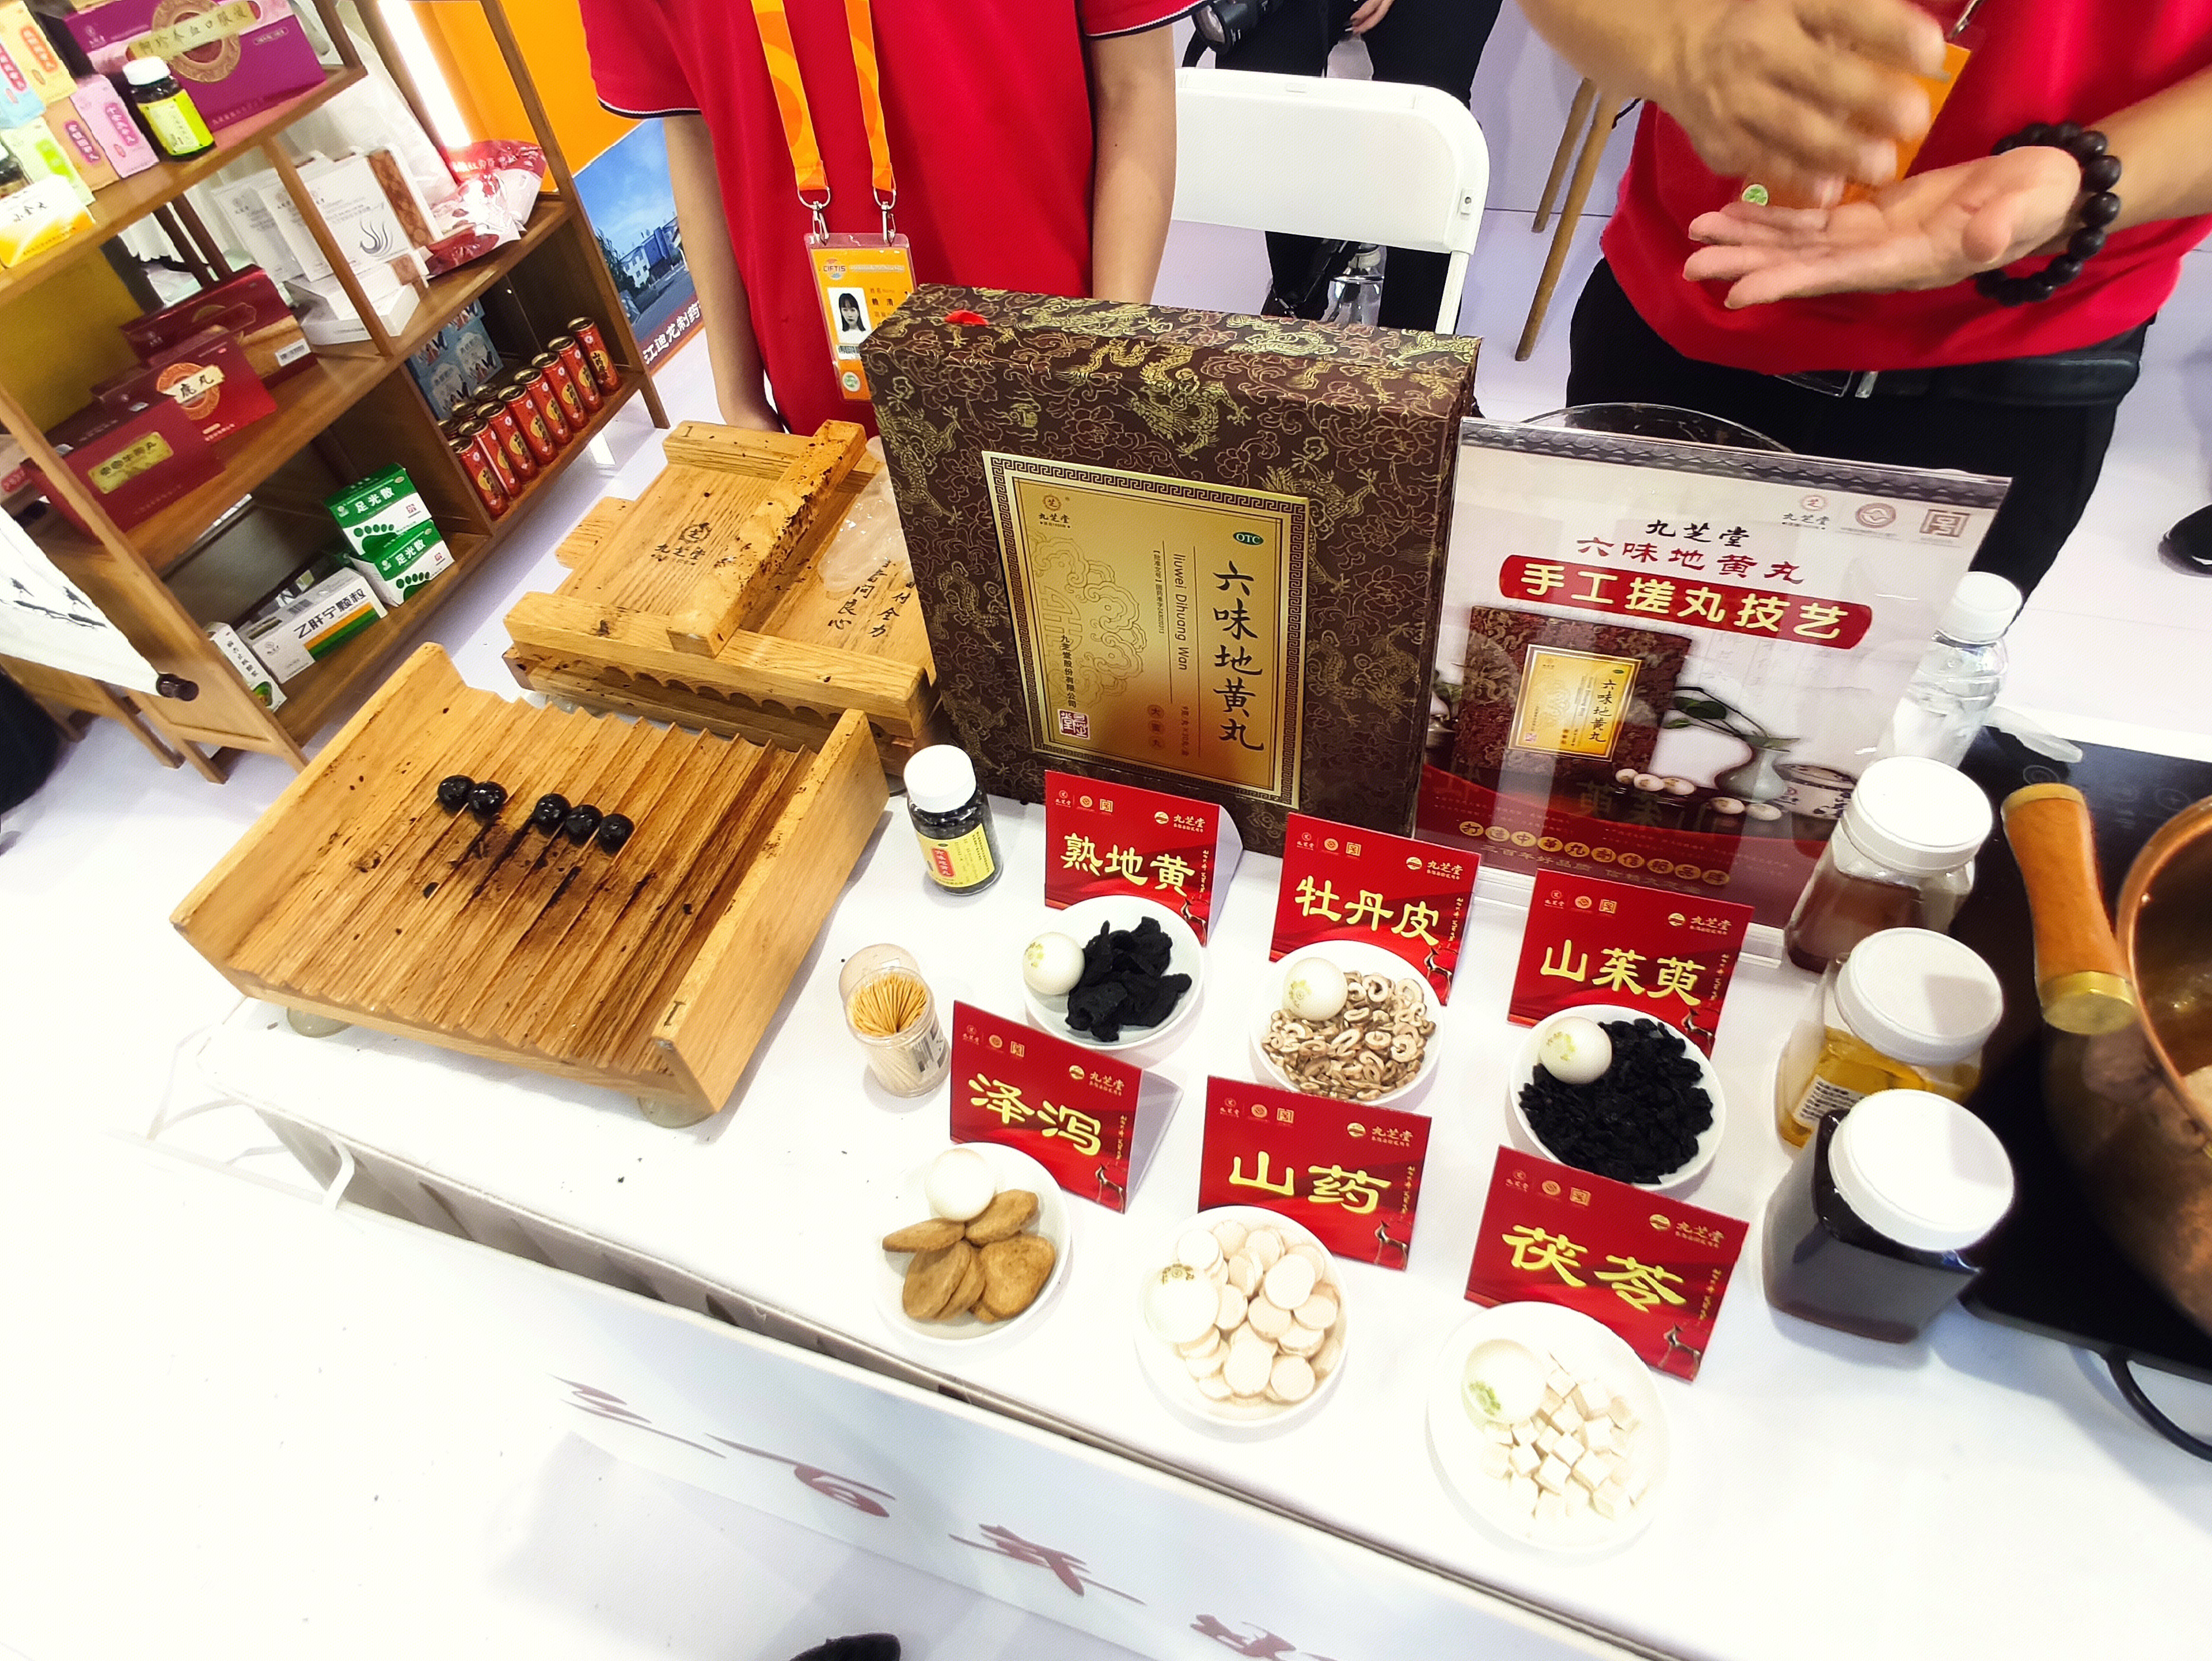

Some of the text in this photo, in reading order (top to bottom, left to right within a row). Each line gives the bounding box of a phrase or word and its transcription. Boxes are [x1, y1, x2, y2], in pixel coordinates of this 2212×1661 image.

[642, 300, 701, 364] 江迪龙制药
[354, 486, 395, 514] 足光散
[1039, 513, 1070, 524] 九芝堂
[1782, 512, 1831, 525] 九芝堂
[395, 539, 426, 566] 足光散
[654, 543, 706, 560] 九芝堂
[1236, 533, 1261, 544] OTC
[1645, 518, 1752, 549] 九芝堂
[1576, 536, 1807, 585] 六味地黄丸
[293, 588, 367, 639] 乙肝宁颗粒
[1174, 593, 1189, 641] Dihuang
[1520, 562, 1850, 640] 手工搓丸技艺
[1060, 634, 1077, 708] 九芝堂股份有限公司
[1177, 647, 1190, 670] Wan
[1212, 560, 1265, 752] 六味地黄丸
[1588, 678, 1617, 743] 六味地黄丸
[1173, 814, 1206, 828] 九芝堂
[1060, 832, 1196, 897] 熟地黄
[1427, 859, 1463, 876] 九芝堂
[1294, 875, 1440, 946] 牡丹皮
[1690, 915, 1733, 932] 九芝堂
[1539, 939, 1707, 1006] 山茱萸
[1089, 1070, 1125, 1089] 九芝堂
[967, 1073, 1102, 1156] 泽泻
[1371, 1126, 1413, 1142] 九芝堂
[1229, 1150, 1392, 1214] 山药
[1675, 1222, 1725, 1243] 九芝堂
[1501, 1224, 1688, 1313] 茯苓
